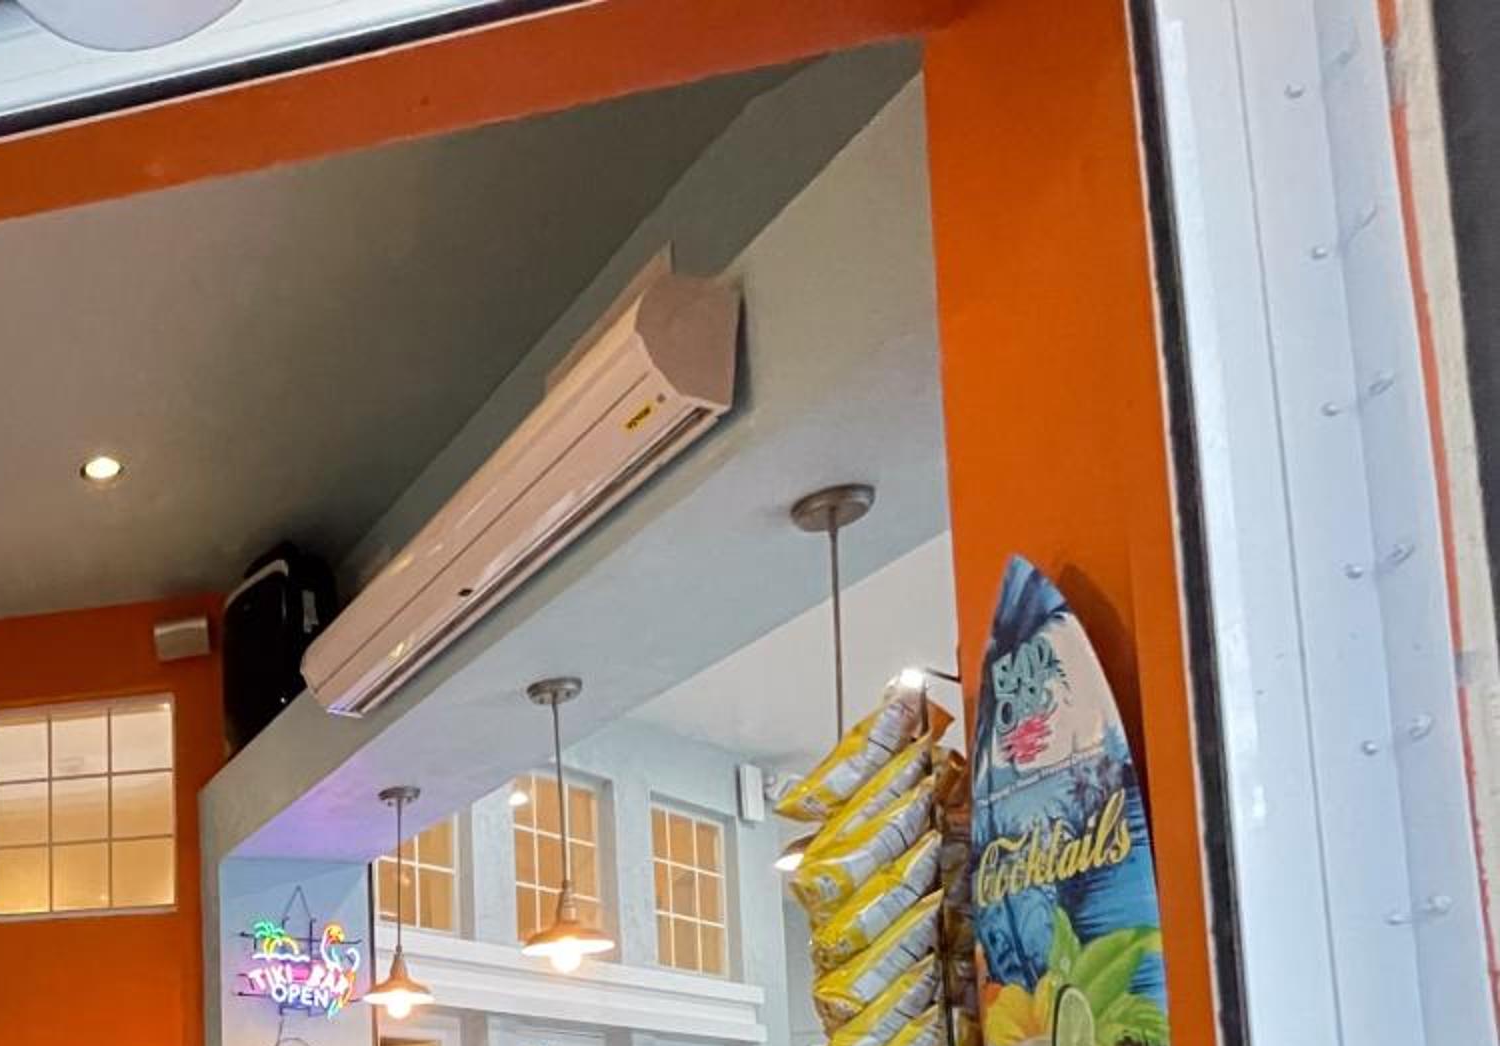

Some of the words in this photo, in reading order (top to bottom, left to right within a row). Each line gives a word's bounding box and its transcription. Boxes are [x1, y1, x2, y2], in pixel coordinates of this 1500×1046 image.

[977, 788, 1131, 907] Cocktails
[248, 964, 293, 991] TIKI
[272, 983, 329, 1008] OPEN
